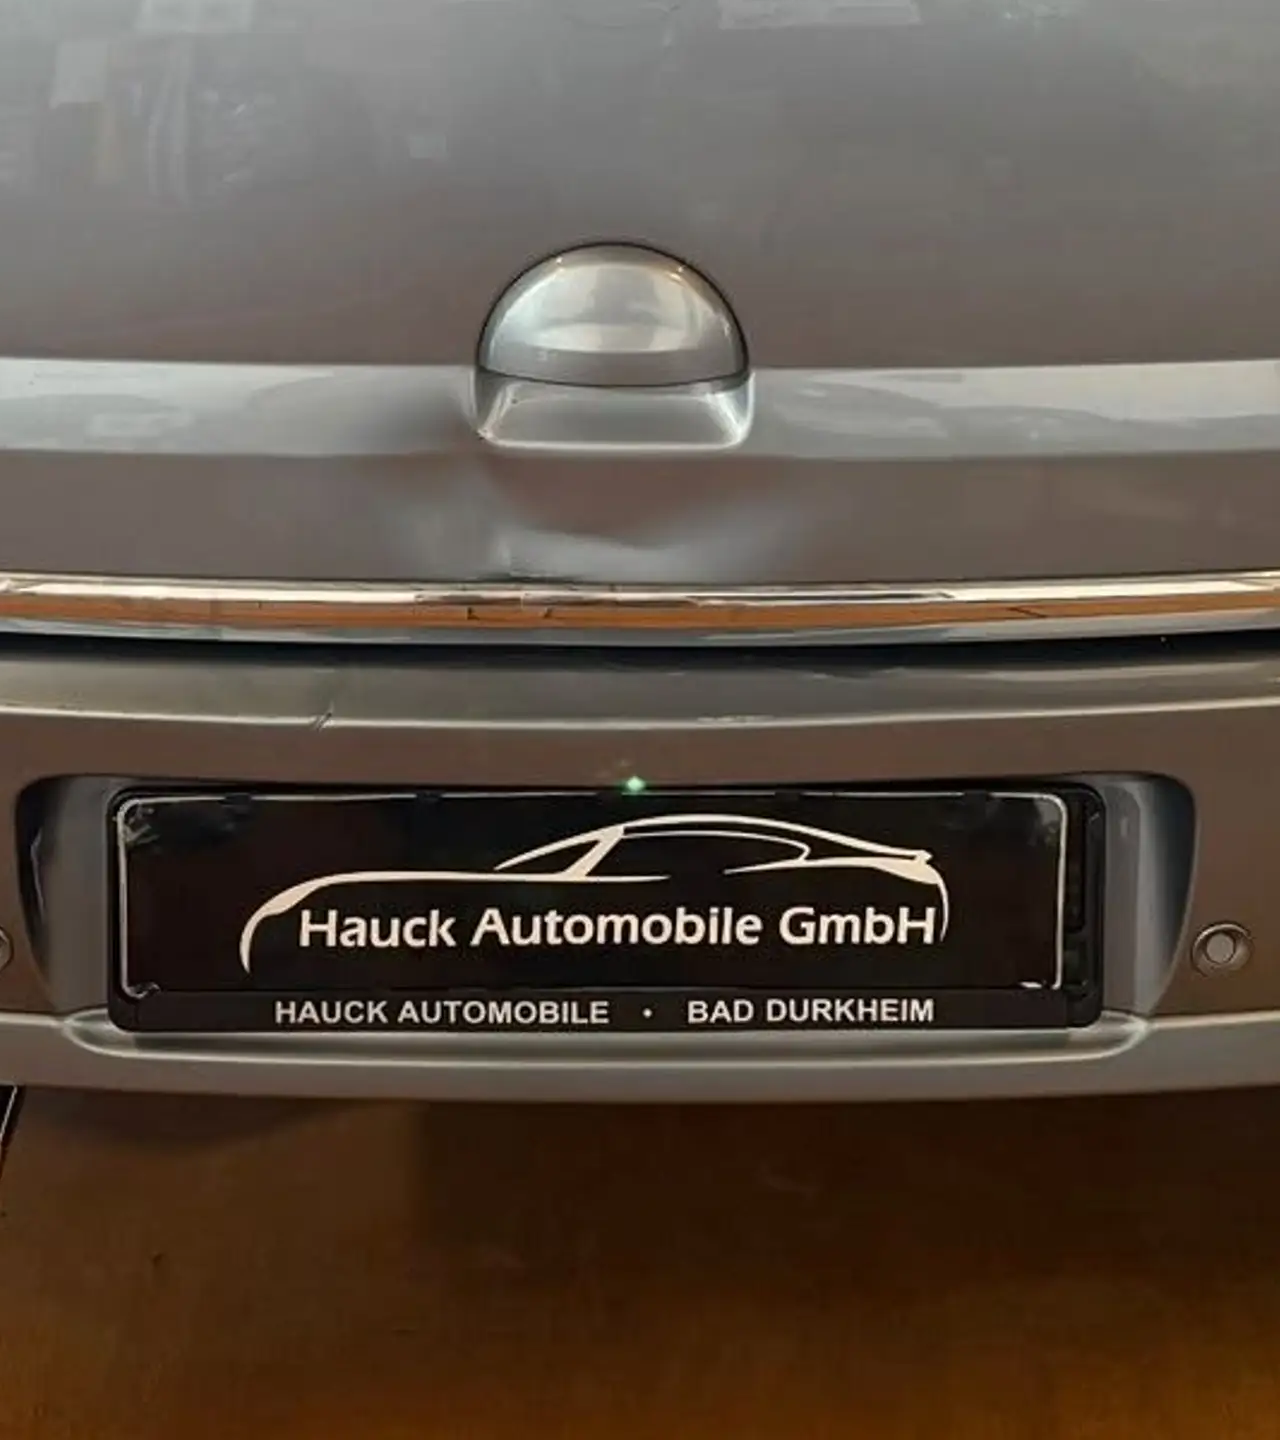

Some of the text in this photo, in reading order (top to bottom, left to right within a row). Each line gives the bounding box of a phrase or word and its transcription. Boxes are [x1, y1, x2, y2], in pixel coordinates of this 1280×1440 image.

[299, 906, 936, 948] Hauck Automobile GmbH
[274, 998, 935, 1024] HAUCK AUTOMOBILE BAD DURKHEIM
